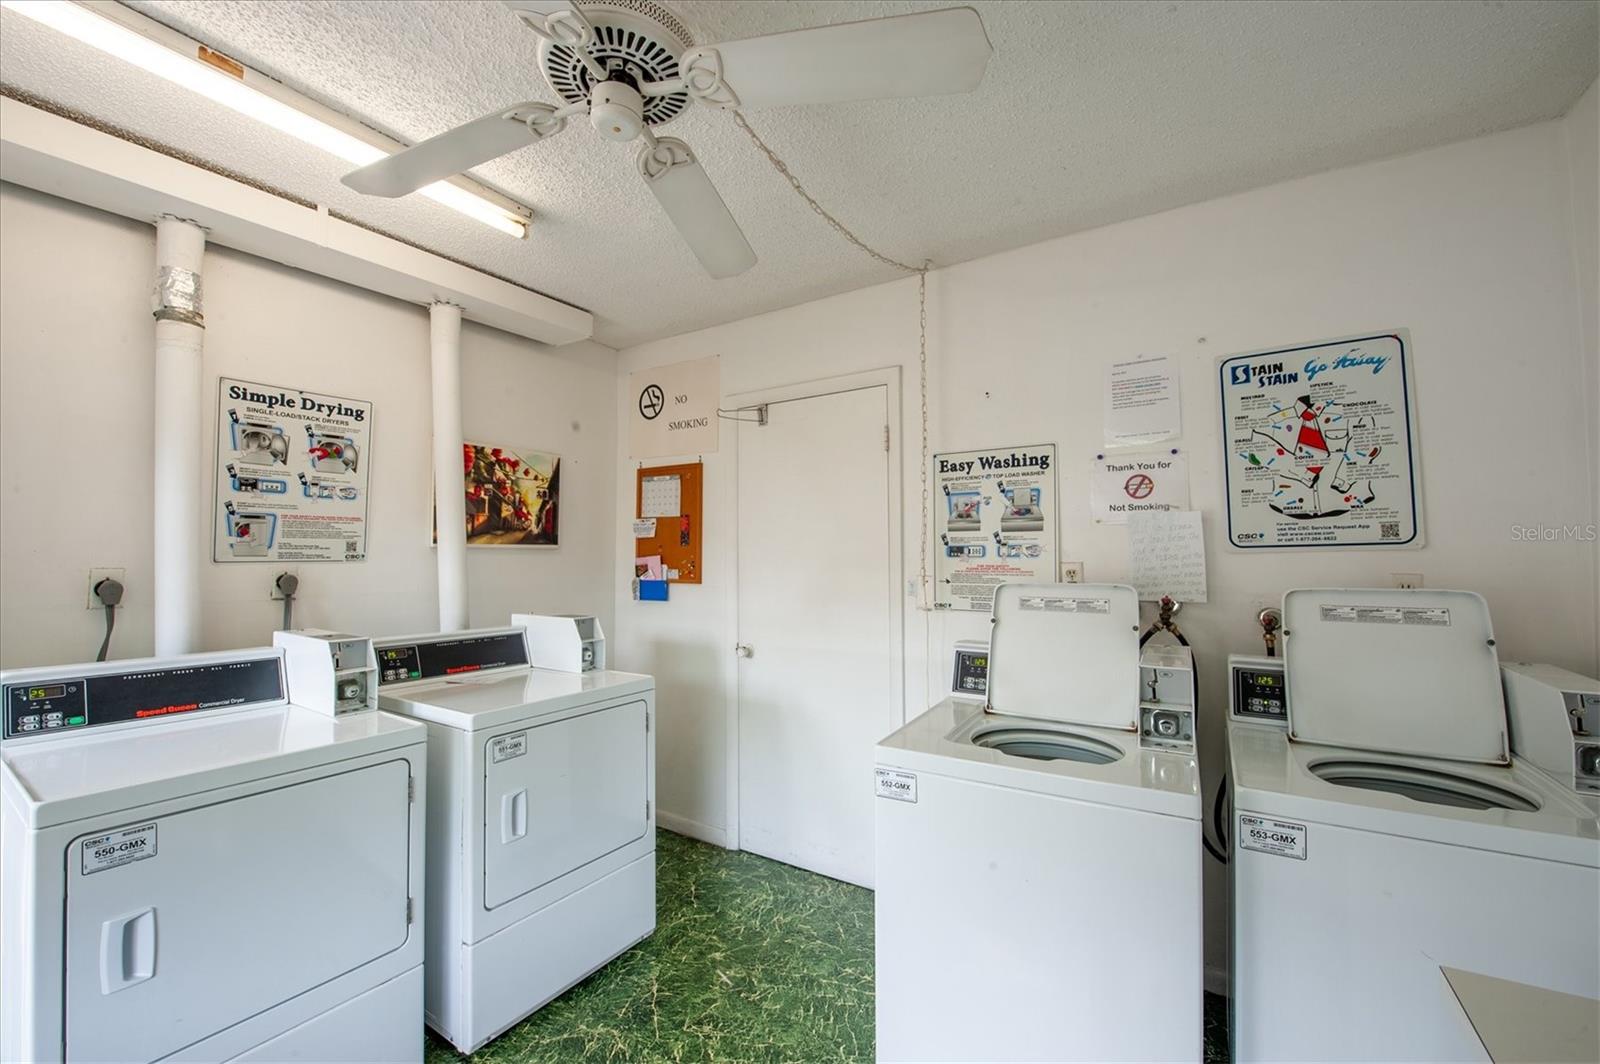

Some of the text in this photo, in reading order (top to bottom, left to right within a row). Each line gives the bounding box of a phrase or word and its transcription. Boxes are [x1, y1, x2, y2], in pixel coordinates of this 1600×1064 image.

[1304, 359, 1327, 381] Go
[1333, 353, 1387, 375] Away
[1258, 372, 1298, 388] STAIN
[229, 385, 365, 422] Simple Drying
[674, 394, 687, 405] NO
[246, 406, 320, 422] SINGLE-LOAD/STACK
[322, 417, 350, 427] DRYERS
[668, 417, 708, 431] SMOKING
[939, 453, 1050, 475] Easy Washing
[1106, 461, 1172, 472] Thank You for
[1109, 503, 1170, 512] Not Smoking
[31, 690, 45, 698] 25
[136, 706, 167, 718] Speed
[168, 703, 197, 713] Queen
[198, 700, 230, 708] Commercial
[881, 780, 910, 791] 552-GMX
[1250, 829, 1296, 845] 553-GMX
[94, 838, 147, 858] 550-GMX
